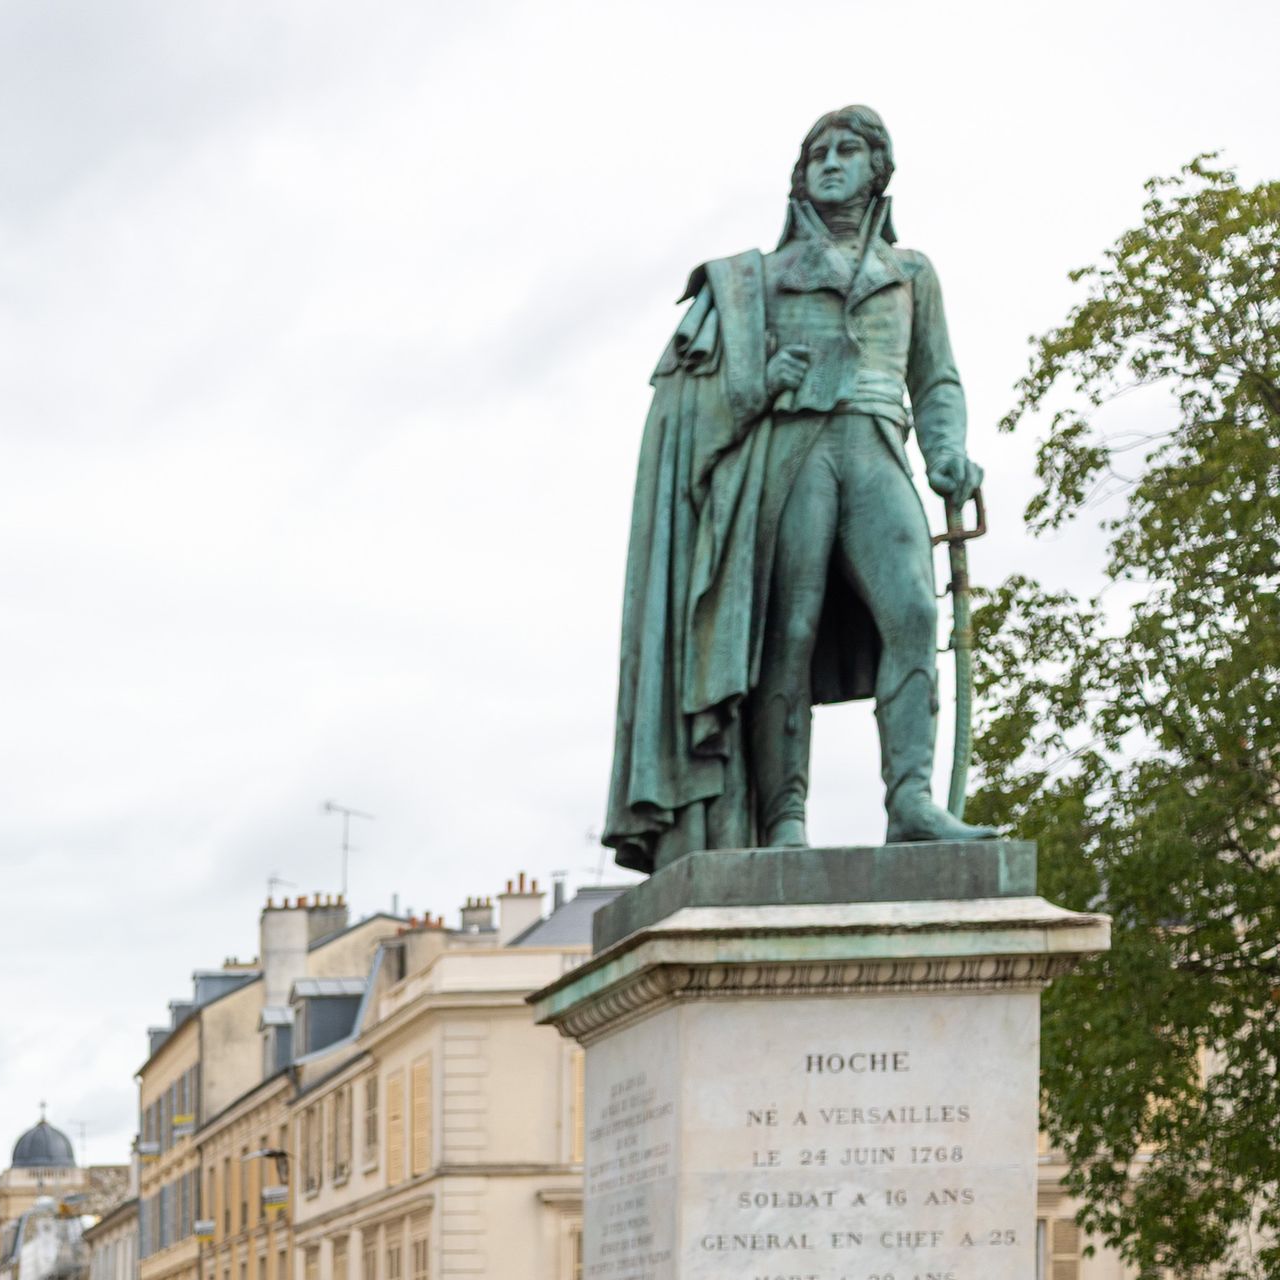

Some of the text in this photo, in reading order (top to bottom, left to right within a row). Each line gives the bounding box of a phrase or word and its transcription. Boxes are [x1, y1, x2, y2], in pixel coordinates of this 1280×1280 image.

[806, 1052, 911, 1074] HOCHE
[819, 1105, 972, 1126] VERSAILLES
[752, 1146, 965, 1168] LE 24 JUIN 1768
[738, 1190, 838, 1209] SOLDAT
[885, 1189, 909, 1207] 16
[924, 1188, 976, 1206] ANS
[830, 1231, 865, 1249] EN
[879, 1230, 944, 1250] CHEF
